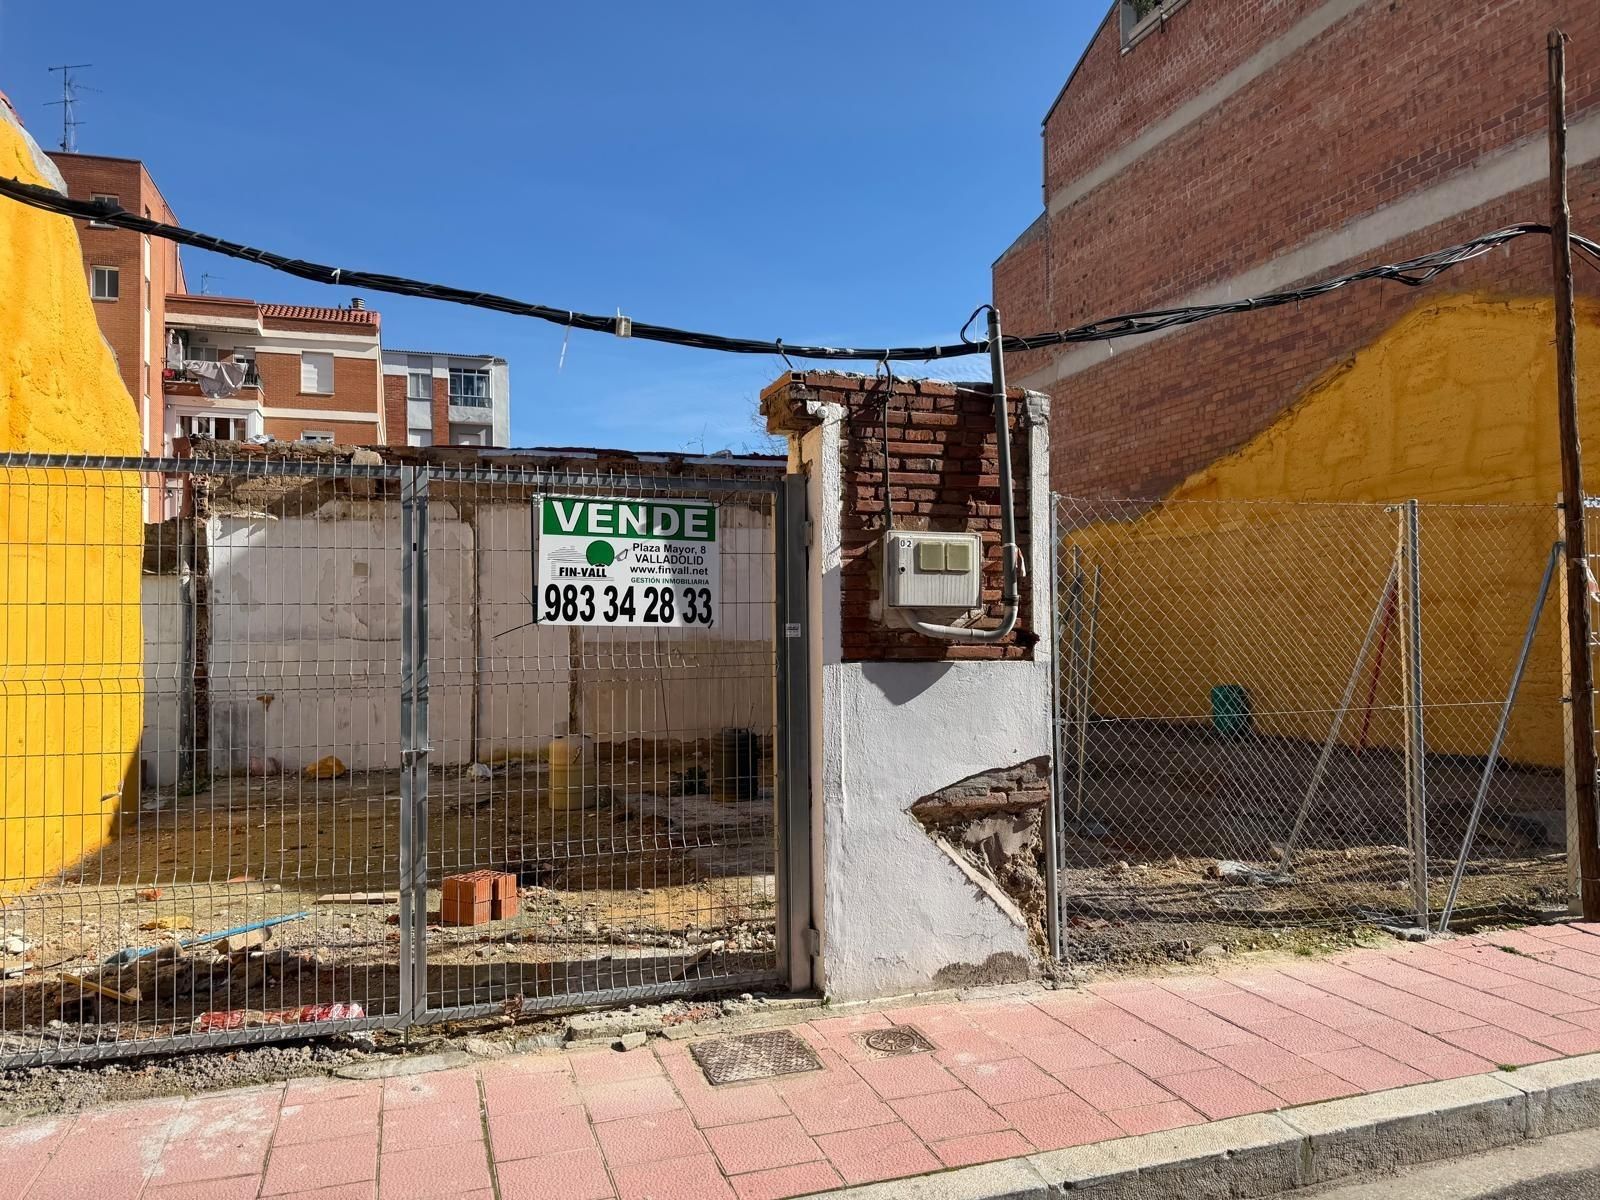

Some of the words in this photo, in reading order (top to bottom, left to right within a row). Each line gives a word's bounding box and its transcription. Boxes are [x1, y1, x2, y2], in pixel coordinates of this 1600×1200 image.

[551, 501, 709, 538] VENDE
[632, 543, 661, 553] Plaza
[700, 545, 707, 555] 8
[635, 554, 704, 566] VALLADOLID
[559, 566, 607, 578] FIN-VALL
[630, 566, 709, 576] www.finvall.net
[631, 577, 661, 585] GESTIÓN
[662, 578, 710, 586] INMOBILIARIA
[545, 584, 596, 623] 983
[603, 585, 636, 623] 34
[643, 586, 675, 624] 28
[682, 587, 712, 625] 33
